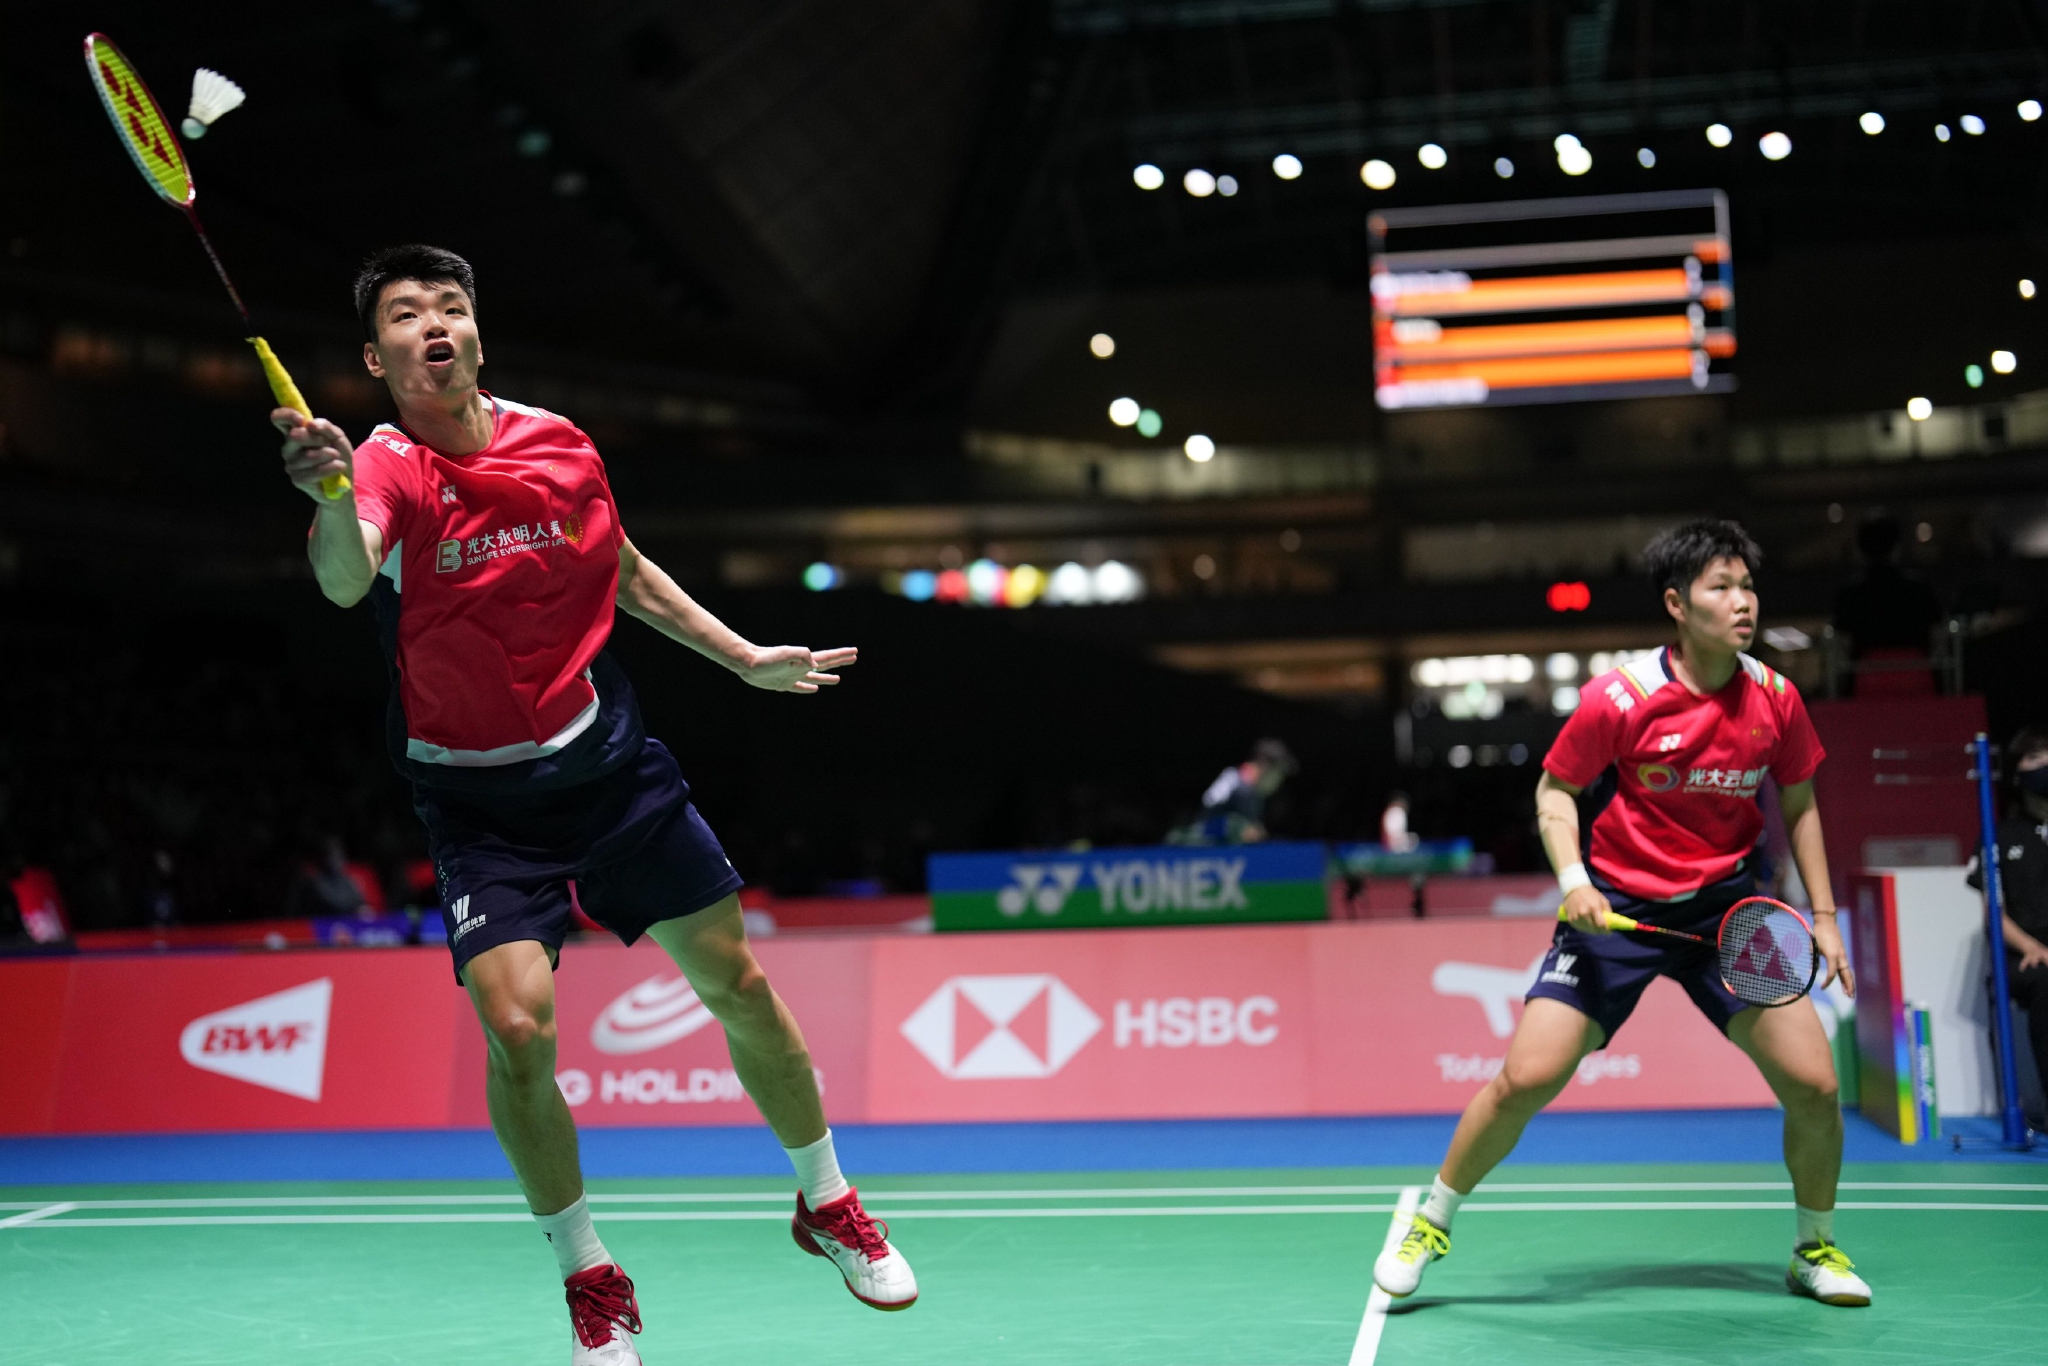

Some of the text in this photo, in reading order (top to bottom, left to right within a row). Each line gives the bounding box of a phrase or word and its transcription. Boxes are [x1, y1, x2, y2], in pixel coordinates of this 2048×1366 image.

[467, 520, 562, 556] 光大永明人寿
[467, 537, 566, 565] SUN LIFE EVERBRIGHT LIFE
[1091, 857, 1247, 914] YONEX
[203, 1024, 311, 1054] BWF
[1113, 996, 1279, 1048] HSBC
[555, 1067, 592, 1106] G
